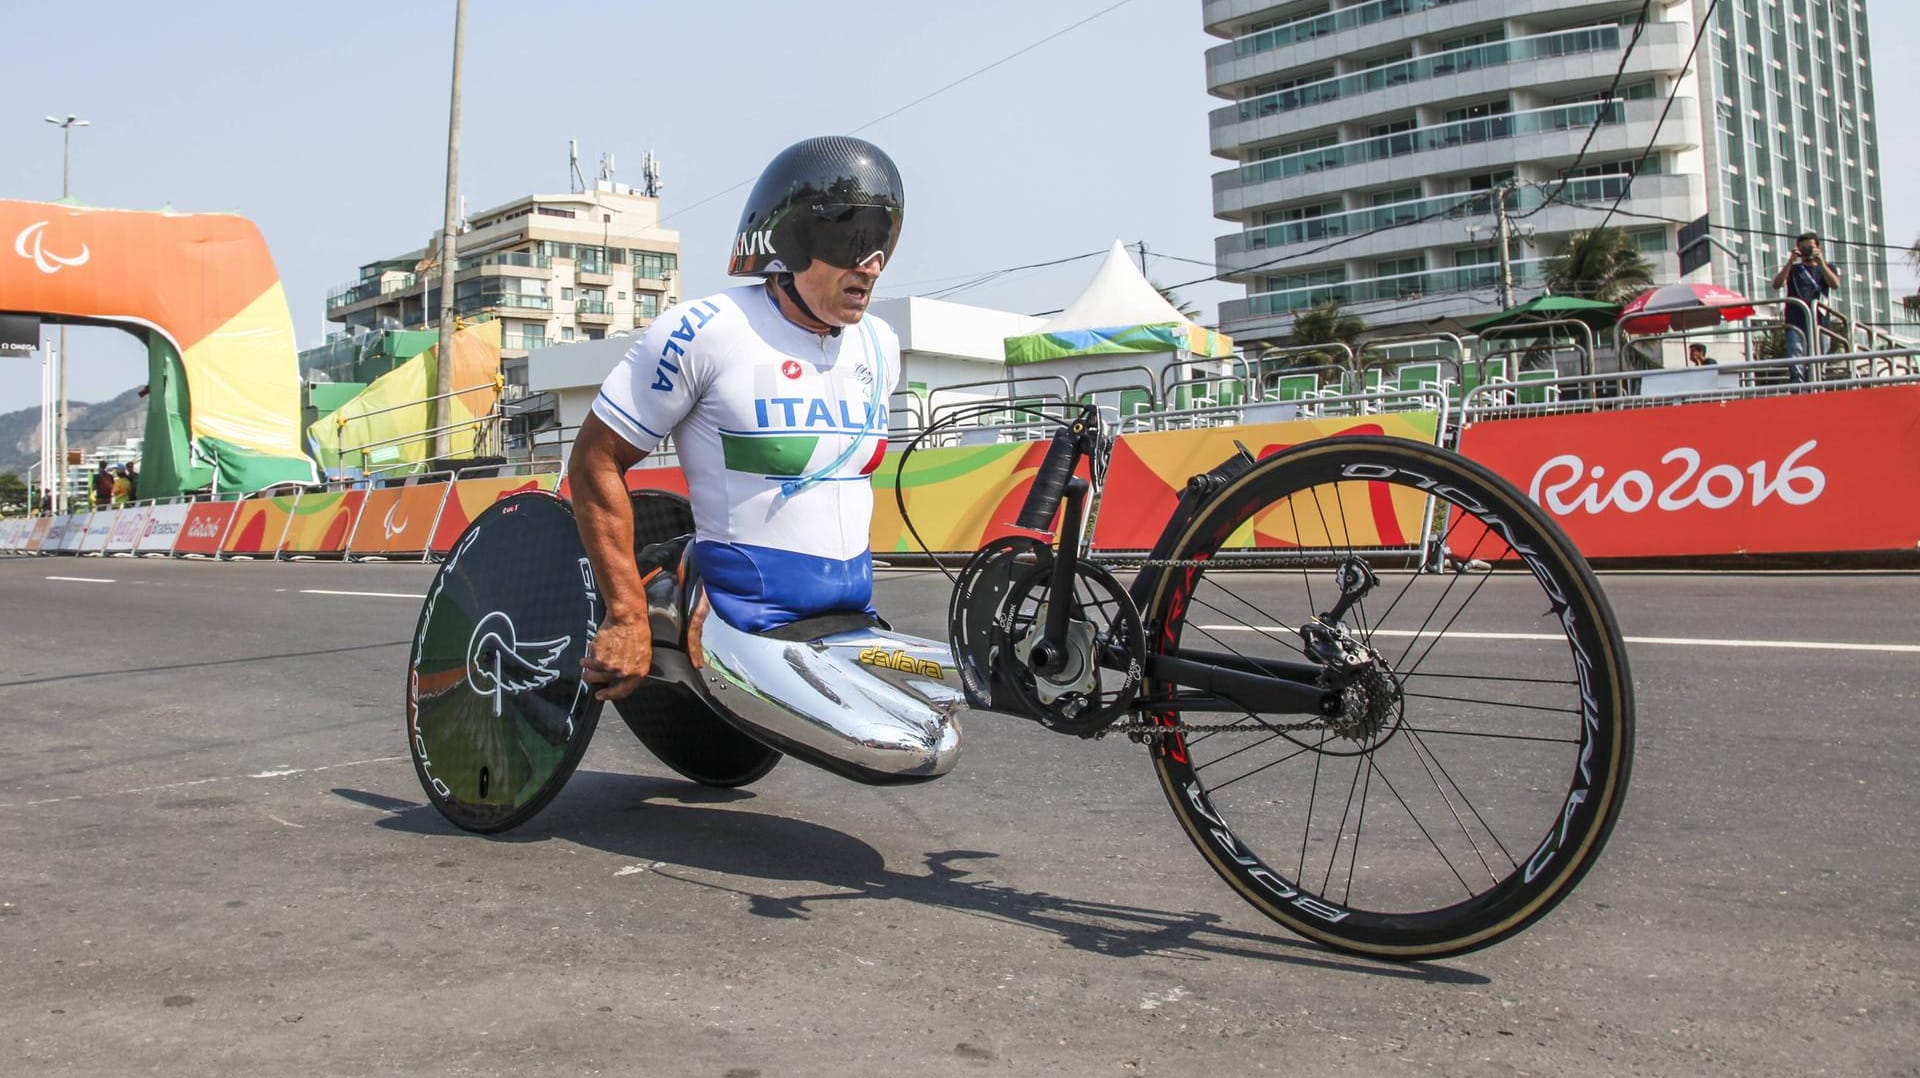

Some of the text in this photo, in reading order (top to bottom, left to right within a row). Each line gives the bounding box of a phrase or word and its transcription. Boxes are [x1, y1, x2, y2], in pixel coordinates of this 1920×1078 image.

[651, 300, 721, 392] ITALIA
[754, 397, 889, 430] ITALIA
[858, 646, 945, 680] dallara
[1341, 463, 1599, 884] CAMPAGNOLO
[1185, 780, 1351, 923] BORA
